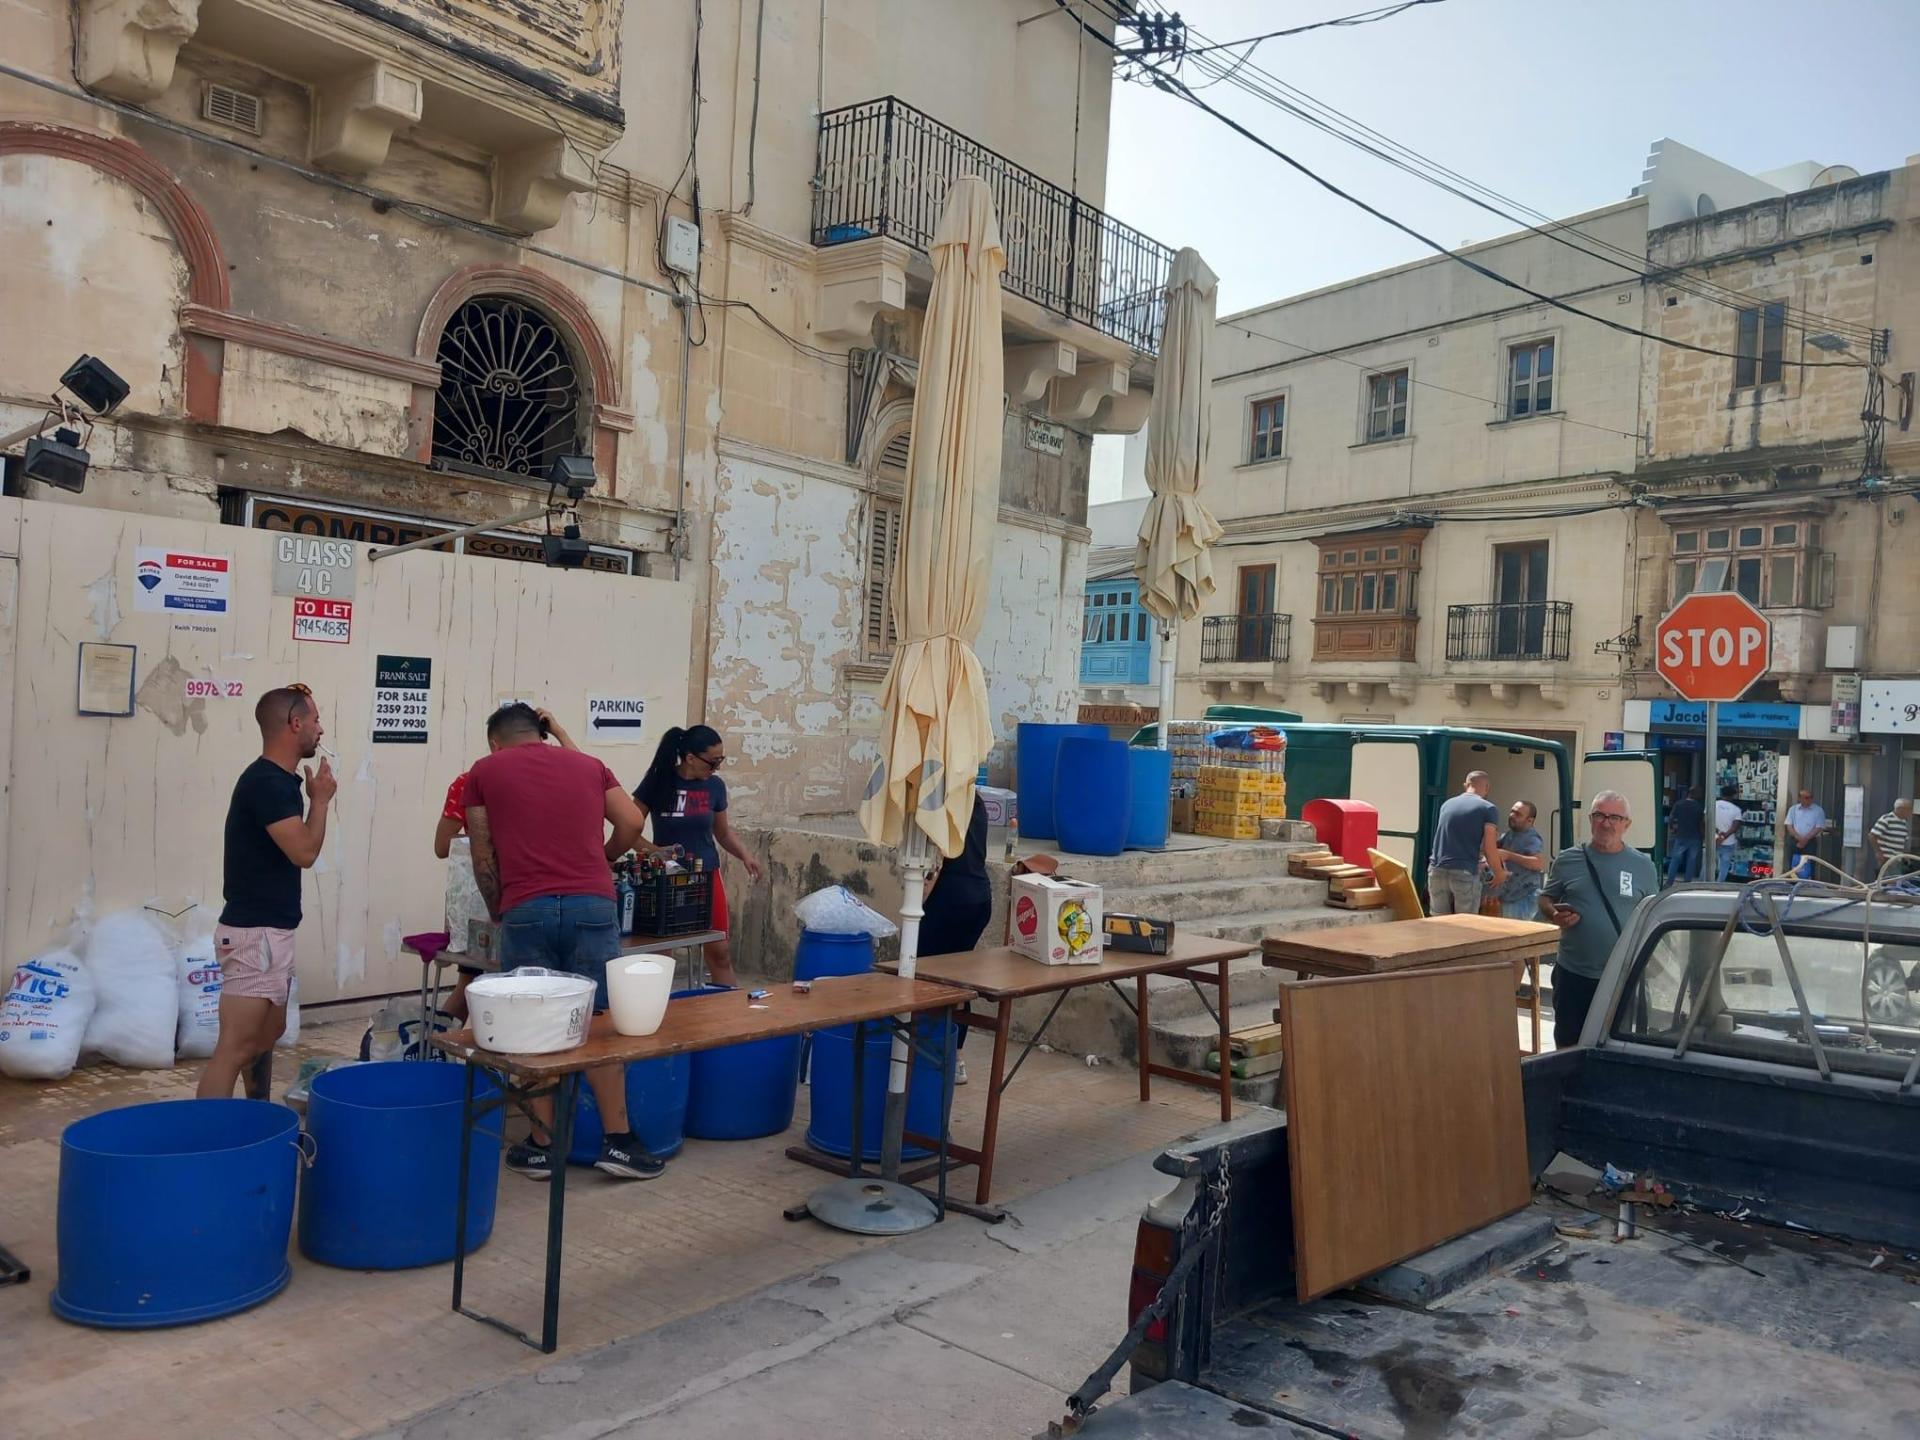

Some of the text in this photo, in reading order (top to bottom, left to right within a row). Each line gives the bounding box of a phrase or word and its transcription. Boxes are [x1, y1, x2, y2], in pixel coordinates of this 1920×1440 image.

[278, 536, 353, 569] CLASS
[177, 558, 217, 569] FOR SALE
[174, 573, 192, 581] David
[295, 601, 351, 618] TO LET
[1663, 627, 1762, 668] STOP
[379, 671, 429, 682] FRANK SALT
[377, 691, 428, 702] FOR SALE
[376, 704, 427, 715] 2359 2312
[590, 699, 645, 714] PARKING
[376, 718, 427, 729] 7997 9930
[527, 1155, 547, 1165] HOKA
[608, 1148, 631, 1163] HOKA
